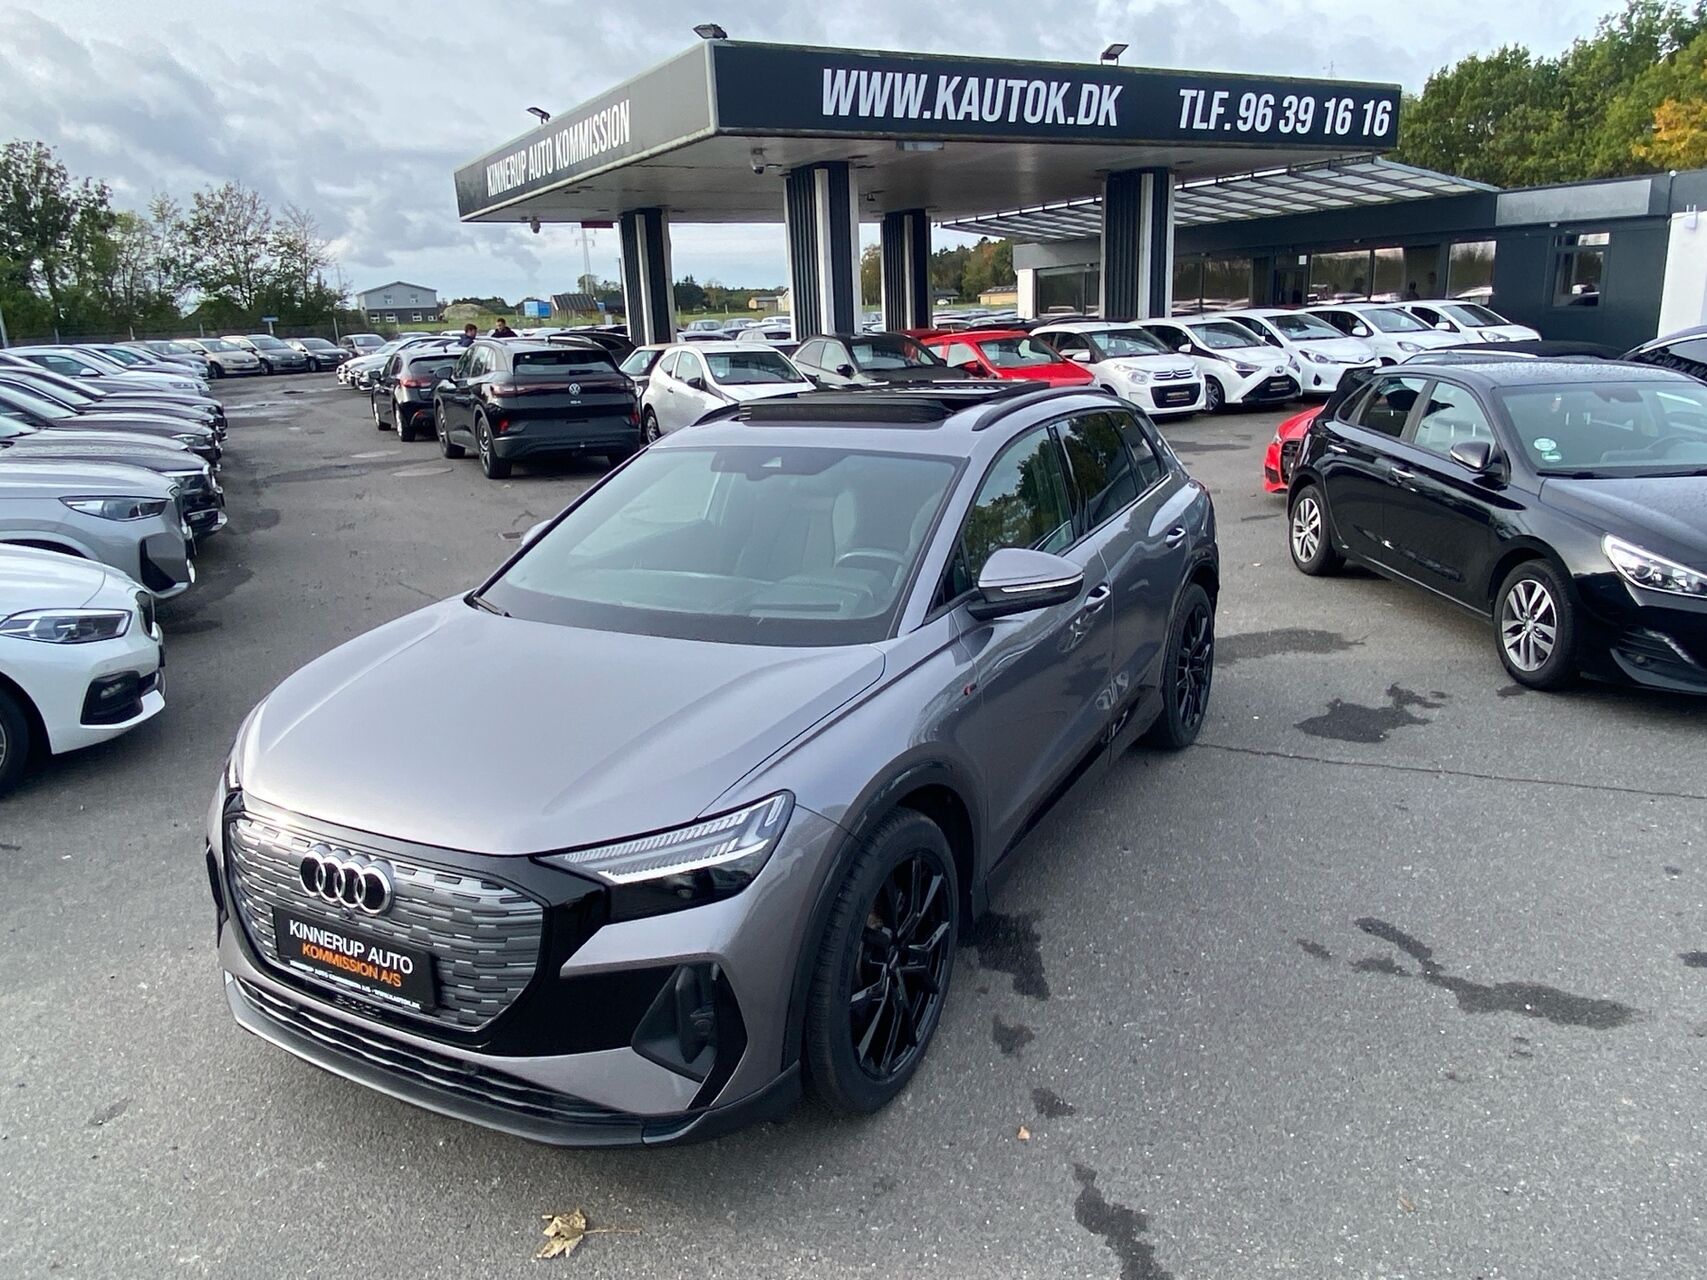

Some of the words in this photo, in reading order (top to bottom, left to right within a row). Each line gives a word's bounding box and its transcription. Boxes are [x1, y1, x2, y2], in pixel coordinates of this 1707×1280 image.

[822, 68, 1123, 127] WWW.KAUTOK.DK
[1179, 89, 1231, 130] TLF.
[1236, 92, 1275, 133] 96
[1278, 95, 1316, 134] 39
[1324, 97, 1354, 136] 16
[1362, 99, 1393, 137] 16
[486, 150, 527, 197] KINNERUP
[528, 137, 554, 181] AUTO
[555, 99, 630, 170] KOMMISSION
[289, 920, 365, 957] KINNERUP
[367, 947, 413, 975] AUTO
[302, 943, 379, 982] KOMMISSION
[380, 972, 402, 987] A/S
